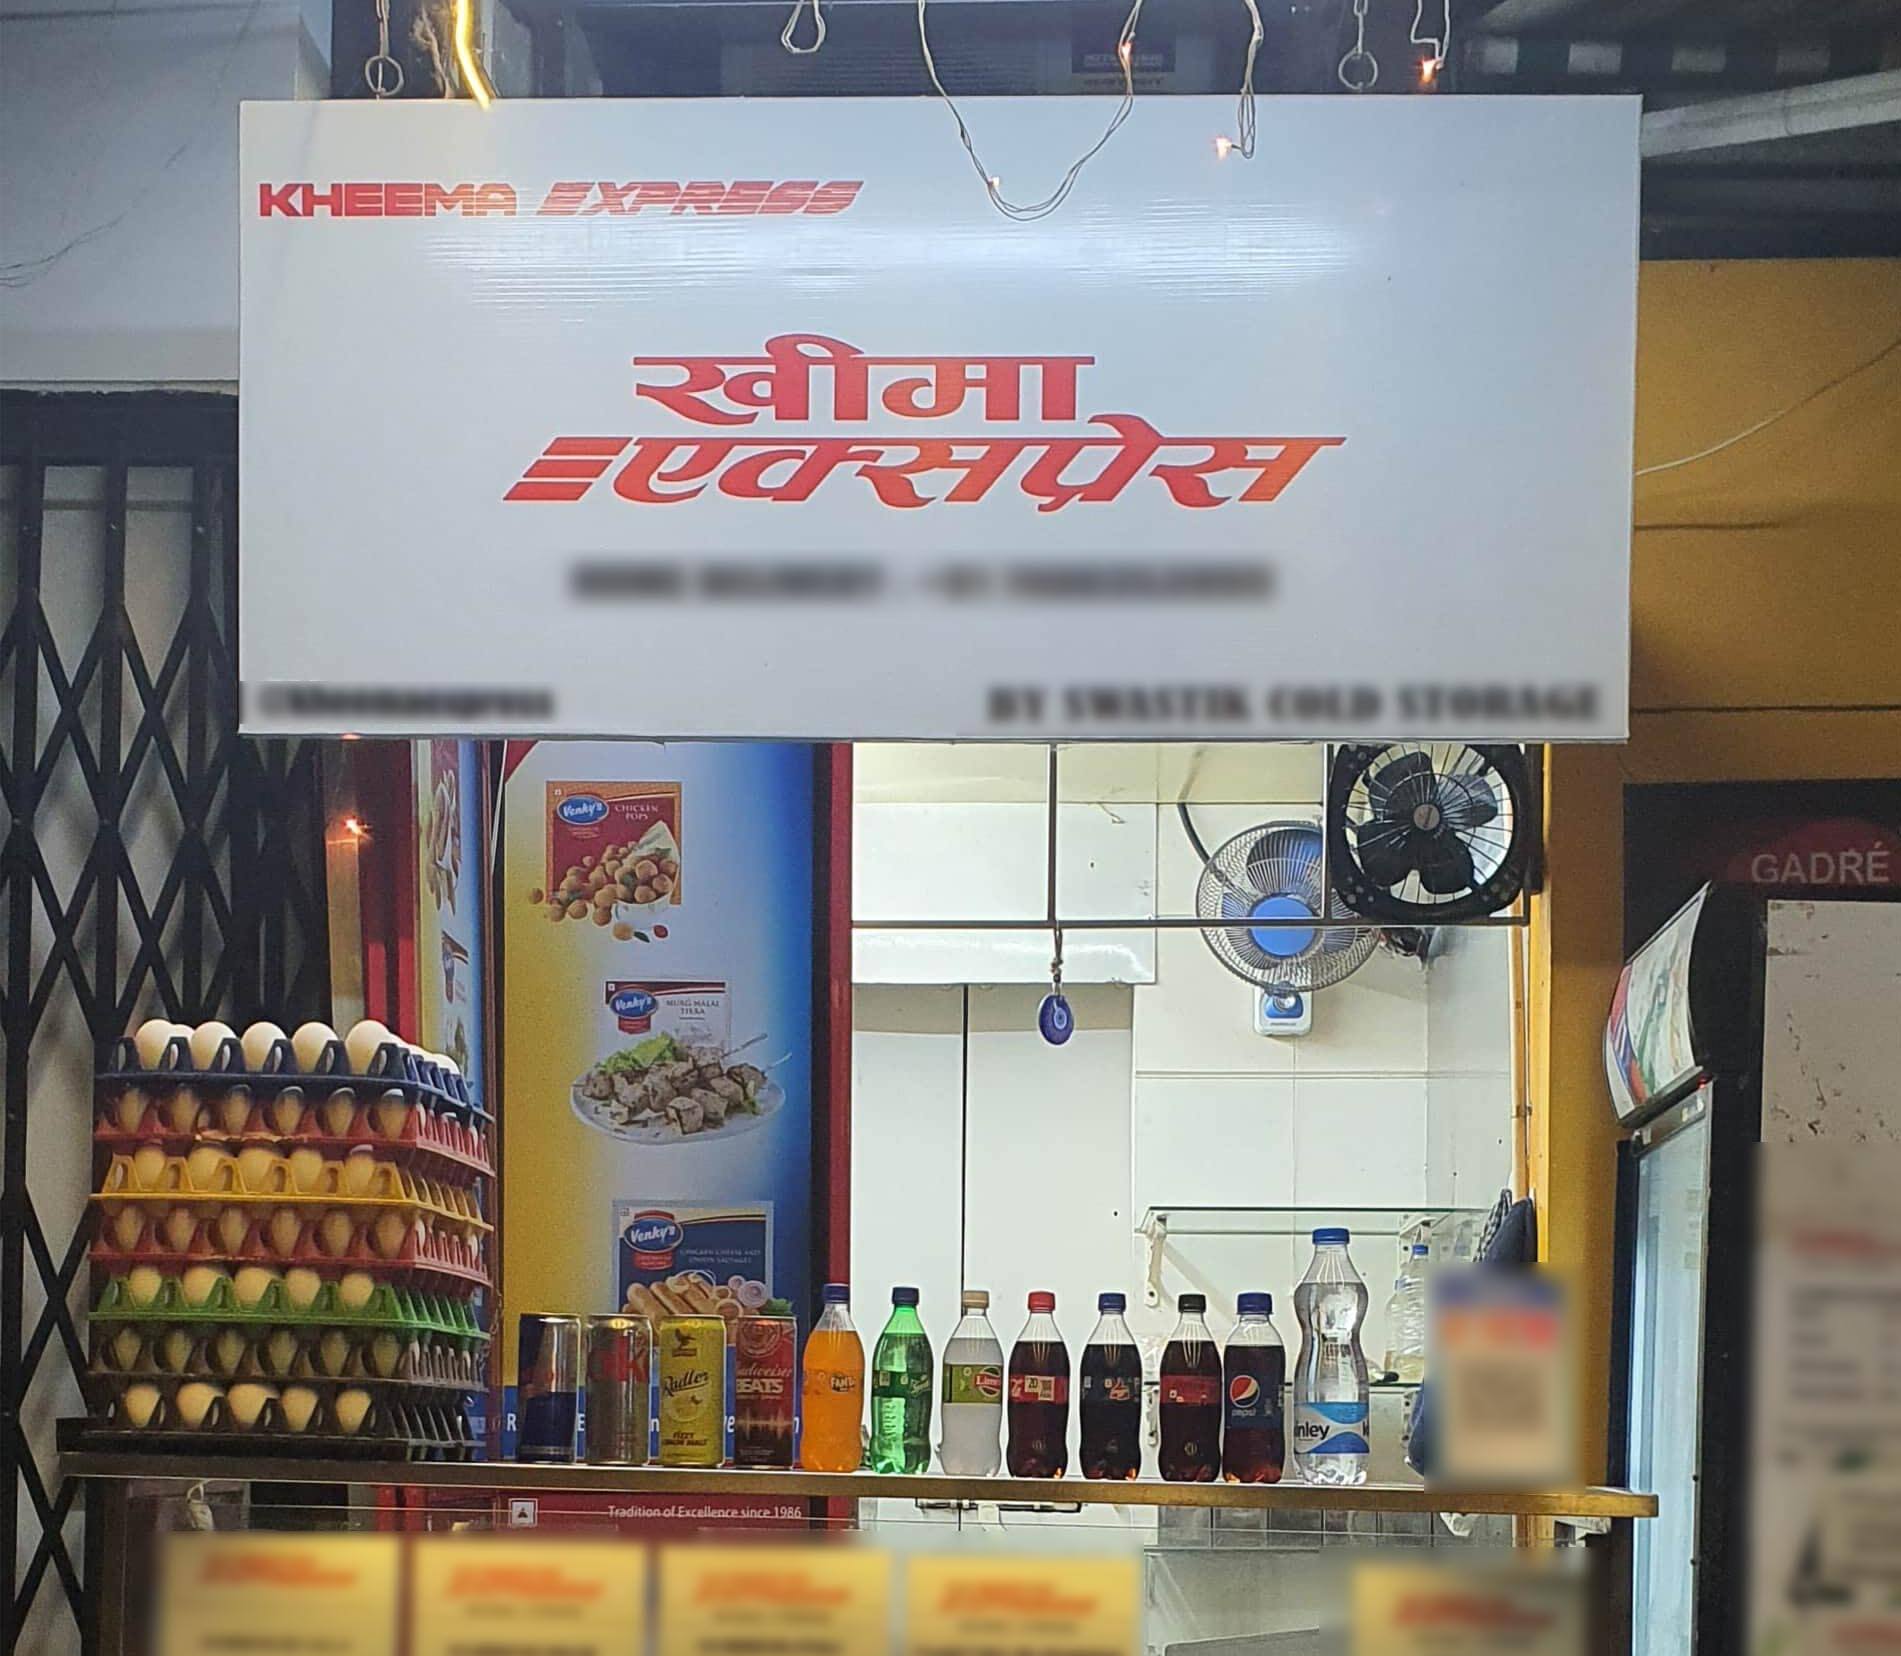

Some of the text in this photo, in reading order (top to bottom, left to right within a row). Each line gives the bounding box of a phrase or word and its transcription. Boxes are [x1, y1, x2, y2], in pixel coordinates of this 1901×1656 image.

[259, 181, 864, 217] KHEEMA EXPRESS
[633, 333, 1095, 426] खीमा
[563, 801, 603, 817] Venky's
[1751, 841, 1890, 884] GADRÉ
[630, 1226, 675, 1243] Venky's
[1232, 1407, 1257, 1418] pepsi
[608, 1505, 802, 1519] Tradition of Excellence since 1986
